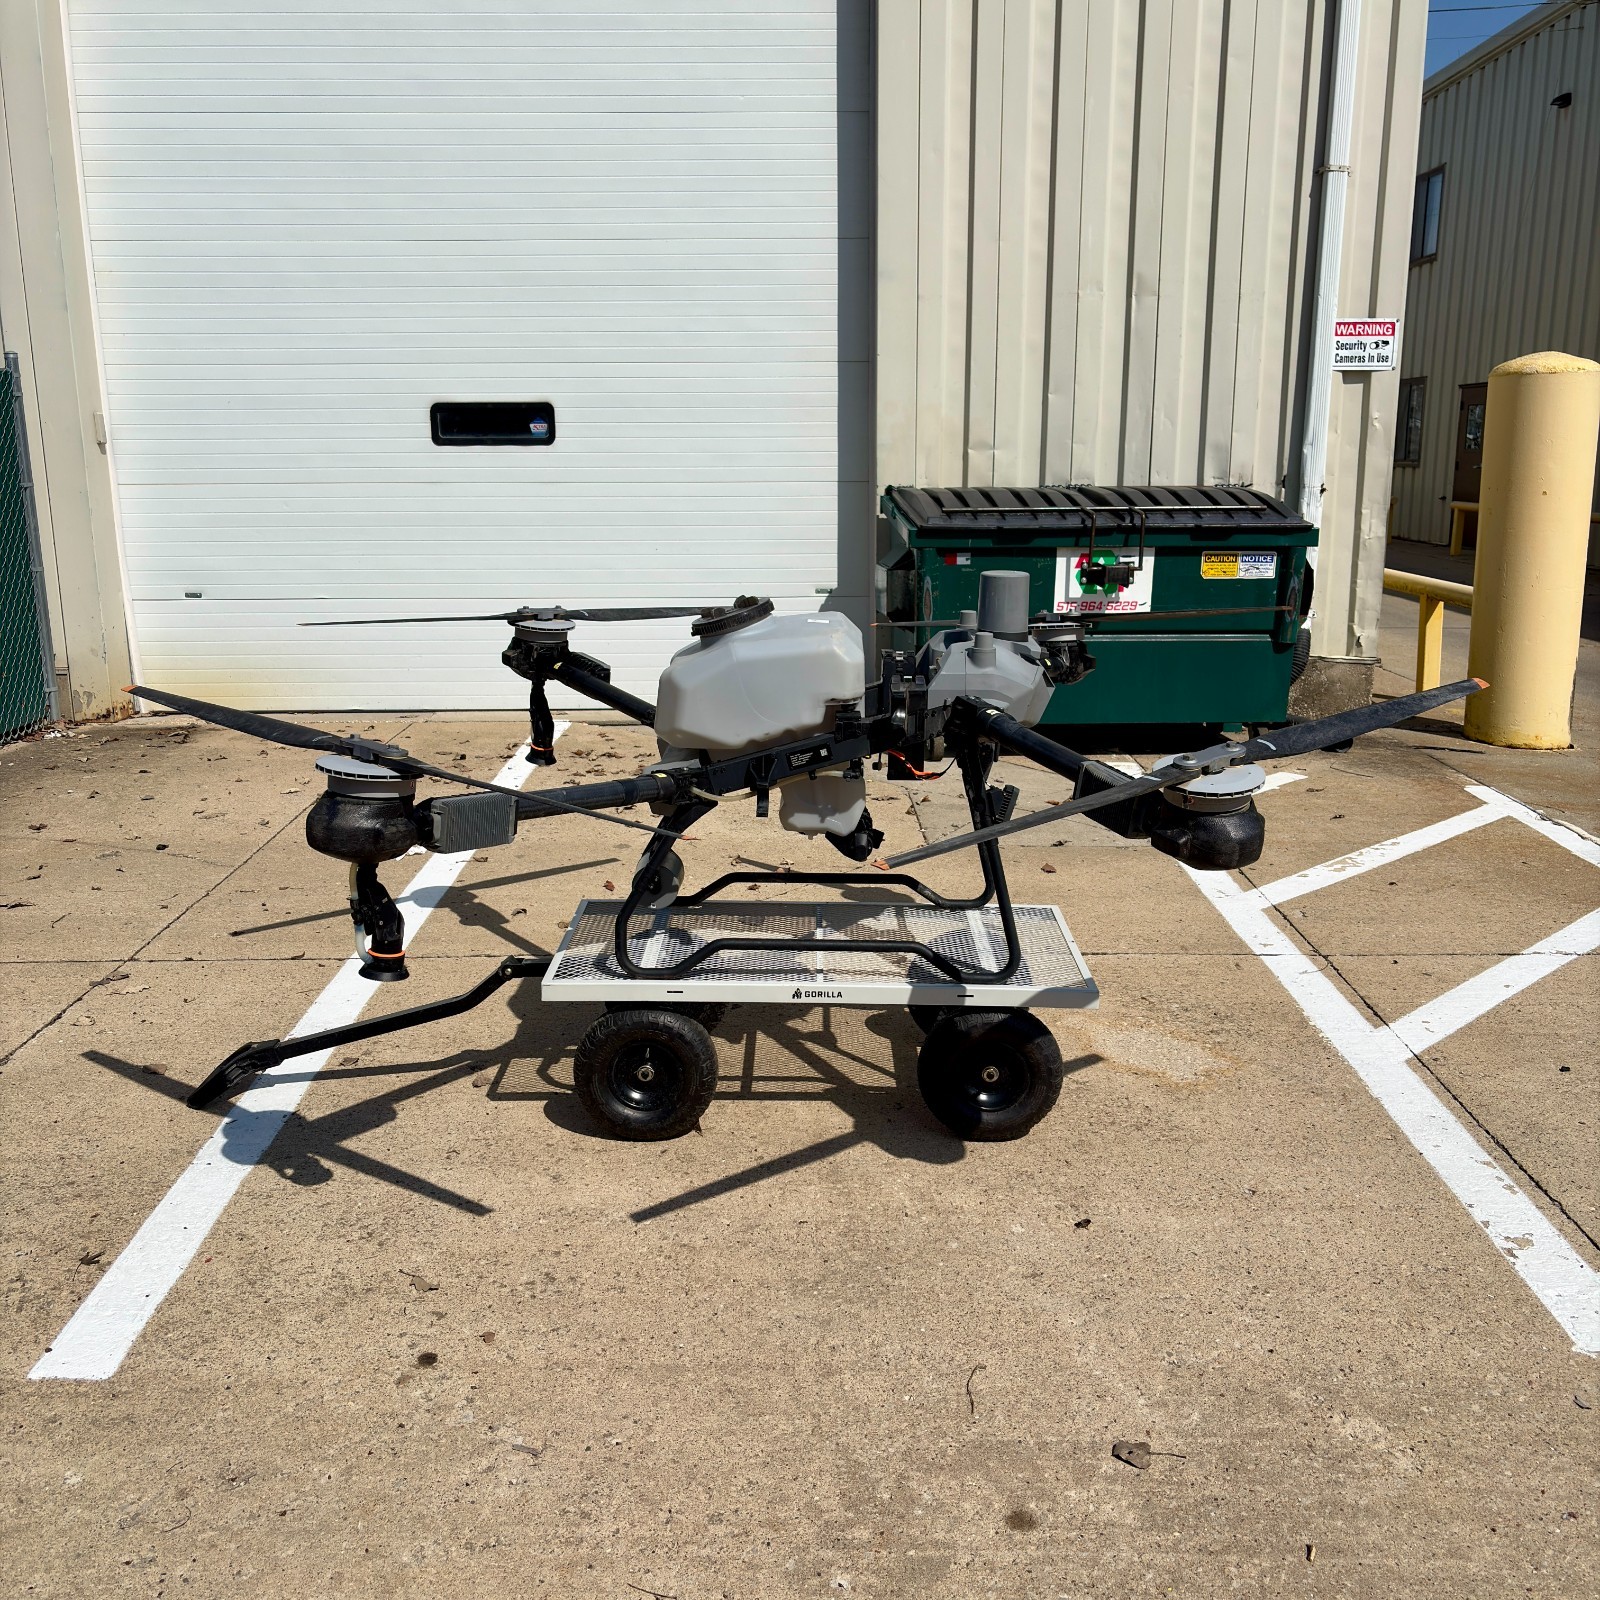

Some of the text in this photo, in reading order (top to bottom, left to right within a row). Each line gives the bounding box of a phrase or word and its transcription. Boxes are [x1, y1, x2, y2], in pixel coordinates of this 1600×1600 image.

[1336, 324, 1392, 335] WARNING
[1335, 340, 1367, 352] Security
[1334, 353, 1390, 364] Cameras In Use
[804, 990, 843, 998] GORILLA
